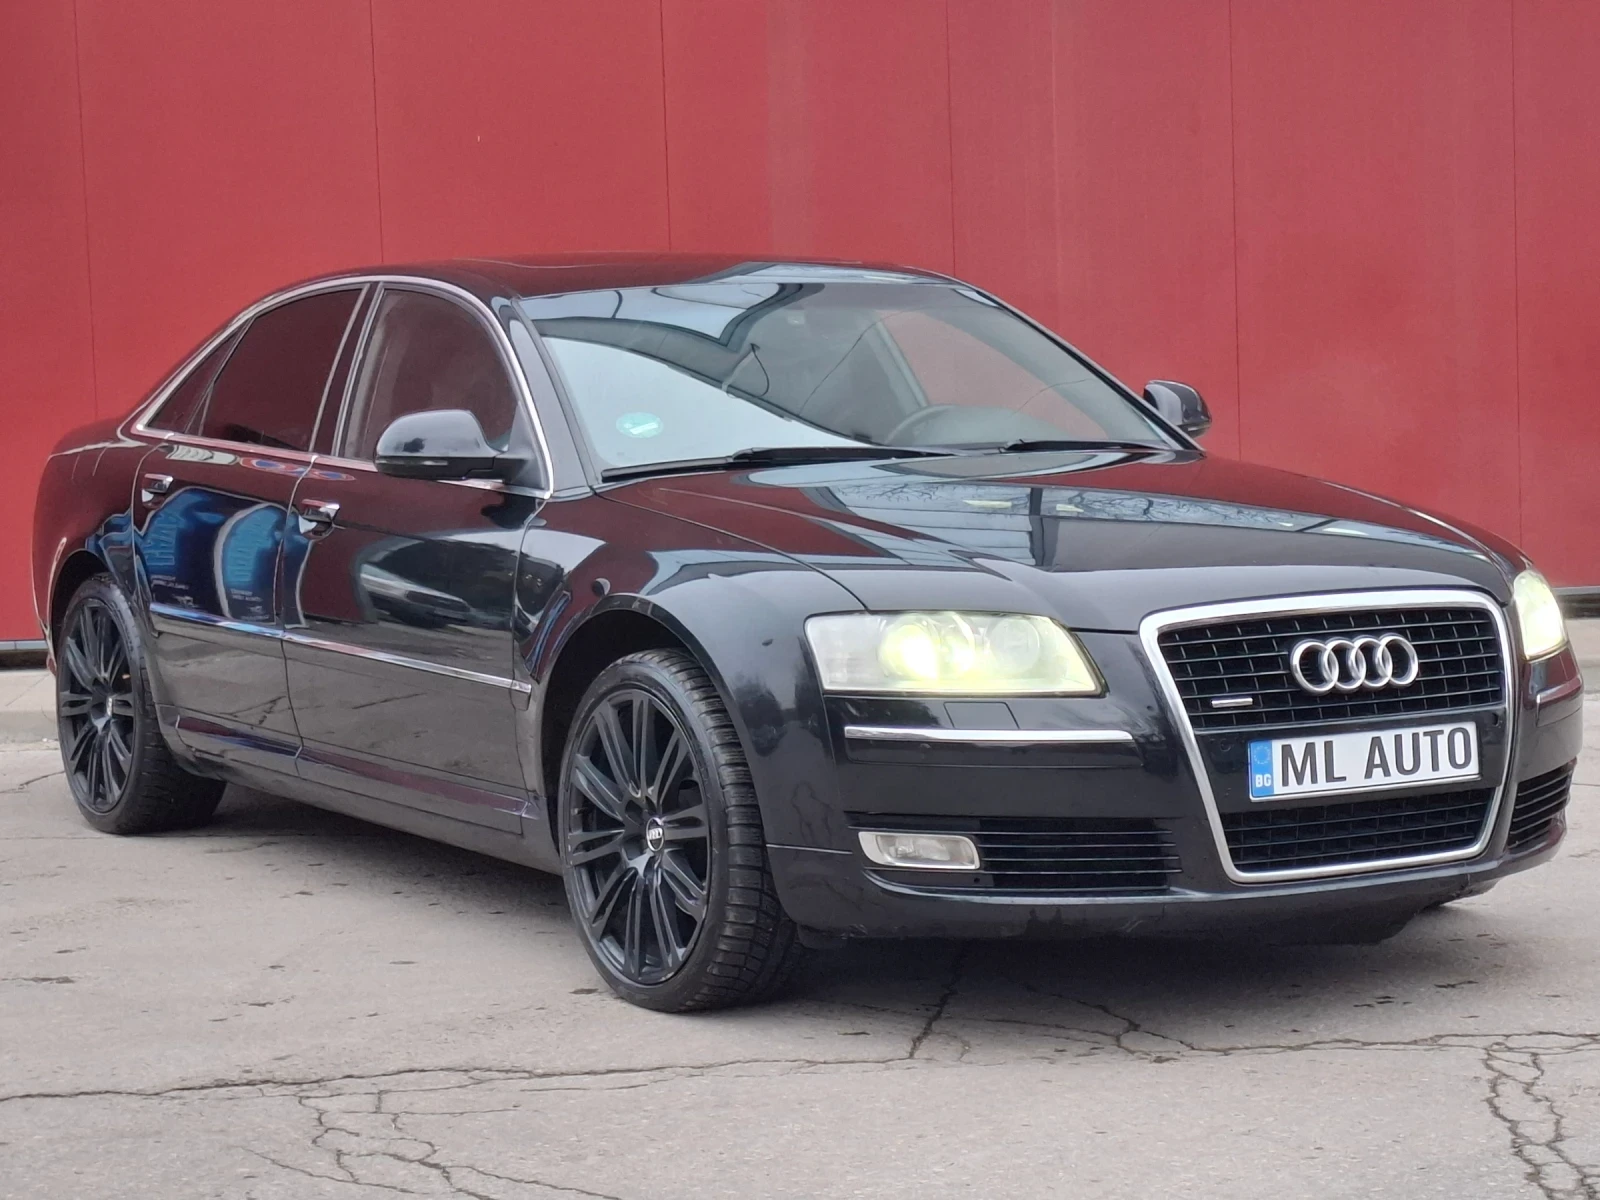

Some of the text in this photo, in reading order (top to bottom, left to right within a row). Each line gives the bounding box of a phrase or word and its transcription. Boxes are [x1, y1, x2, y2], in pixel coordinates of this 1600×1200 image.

[1281, 727, 1472, 787] ML AUTO
[1255, 773, 1271, 787] BG
